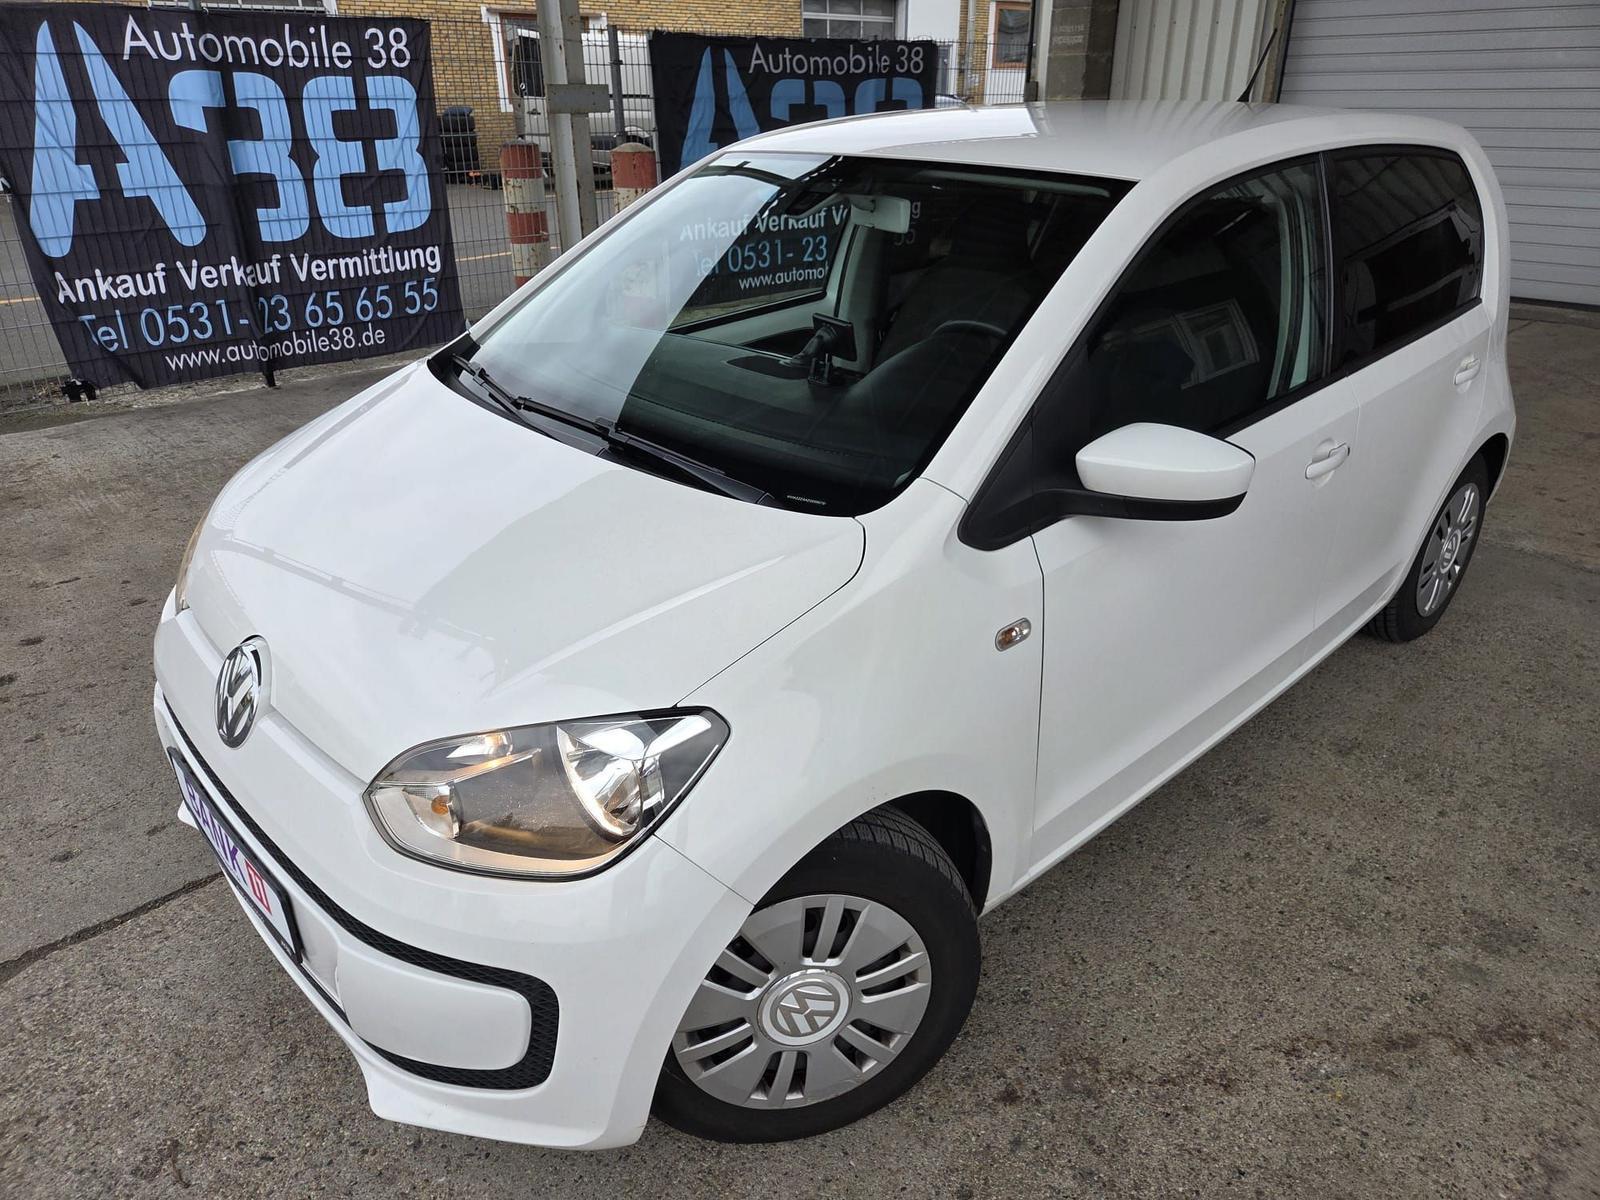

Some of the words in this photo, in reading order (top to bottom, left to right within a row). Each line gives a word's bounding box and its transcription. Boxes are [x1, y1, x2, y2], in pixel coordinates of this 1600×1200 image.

[123, 14, 352, 69] Automobile
[365, 27, 411, 69] 38
[748, 42, 891, 76] Automobile
[895, 45, 924, 74] 38
[679, 214, 751, 241] Ankauf
[802, 235, 828, 262] 23
[54, 262, 167, 304] Ankauf
[176, 254, 282, 291] Verkauf
[289, 245, 441, 282] Vermittlung
[78, 309, 129, 352] Tel
[258, 294, 292, 334] 23
[305, 291, 344, 328] 65
[356, 285, 393, 322] 65
[404, 277, 438, 315] 55
[165, 323, 386, 371] www.automobile38.de
